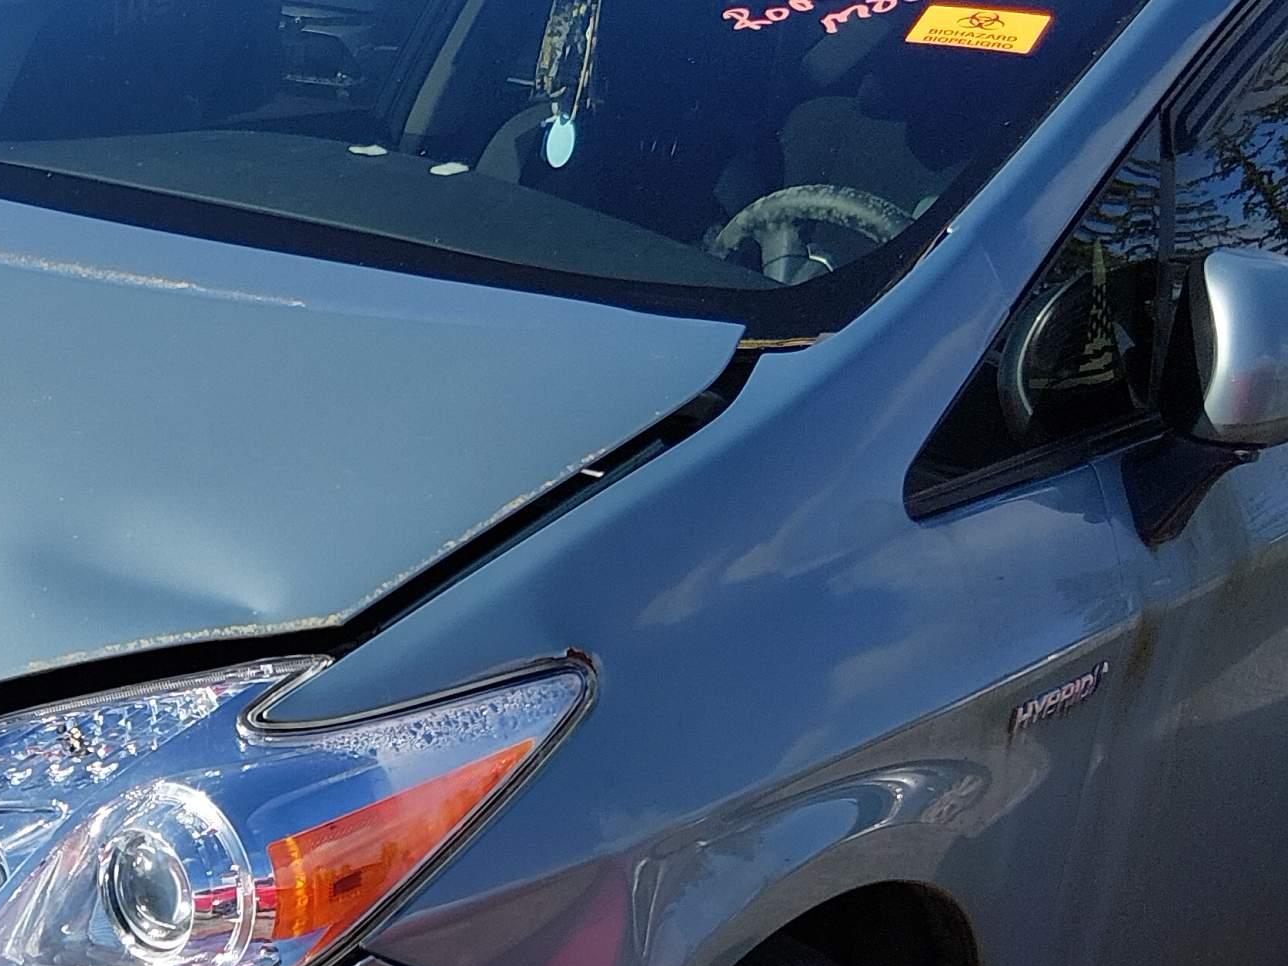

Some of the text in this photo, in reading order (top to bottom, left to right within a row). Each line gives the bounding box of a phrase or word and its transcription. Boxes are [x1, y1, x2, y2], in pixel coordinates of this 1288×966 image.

[928, 28, 1018, 42] BIOHAZARD
[923, 36, 1014, 49] BIOPELIGRO
[1014, 671, 1094, 732] HYBRID
